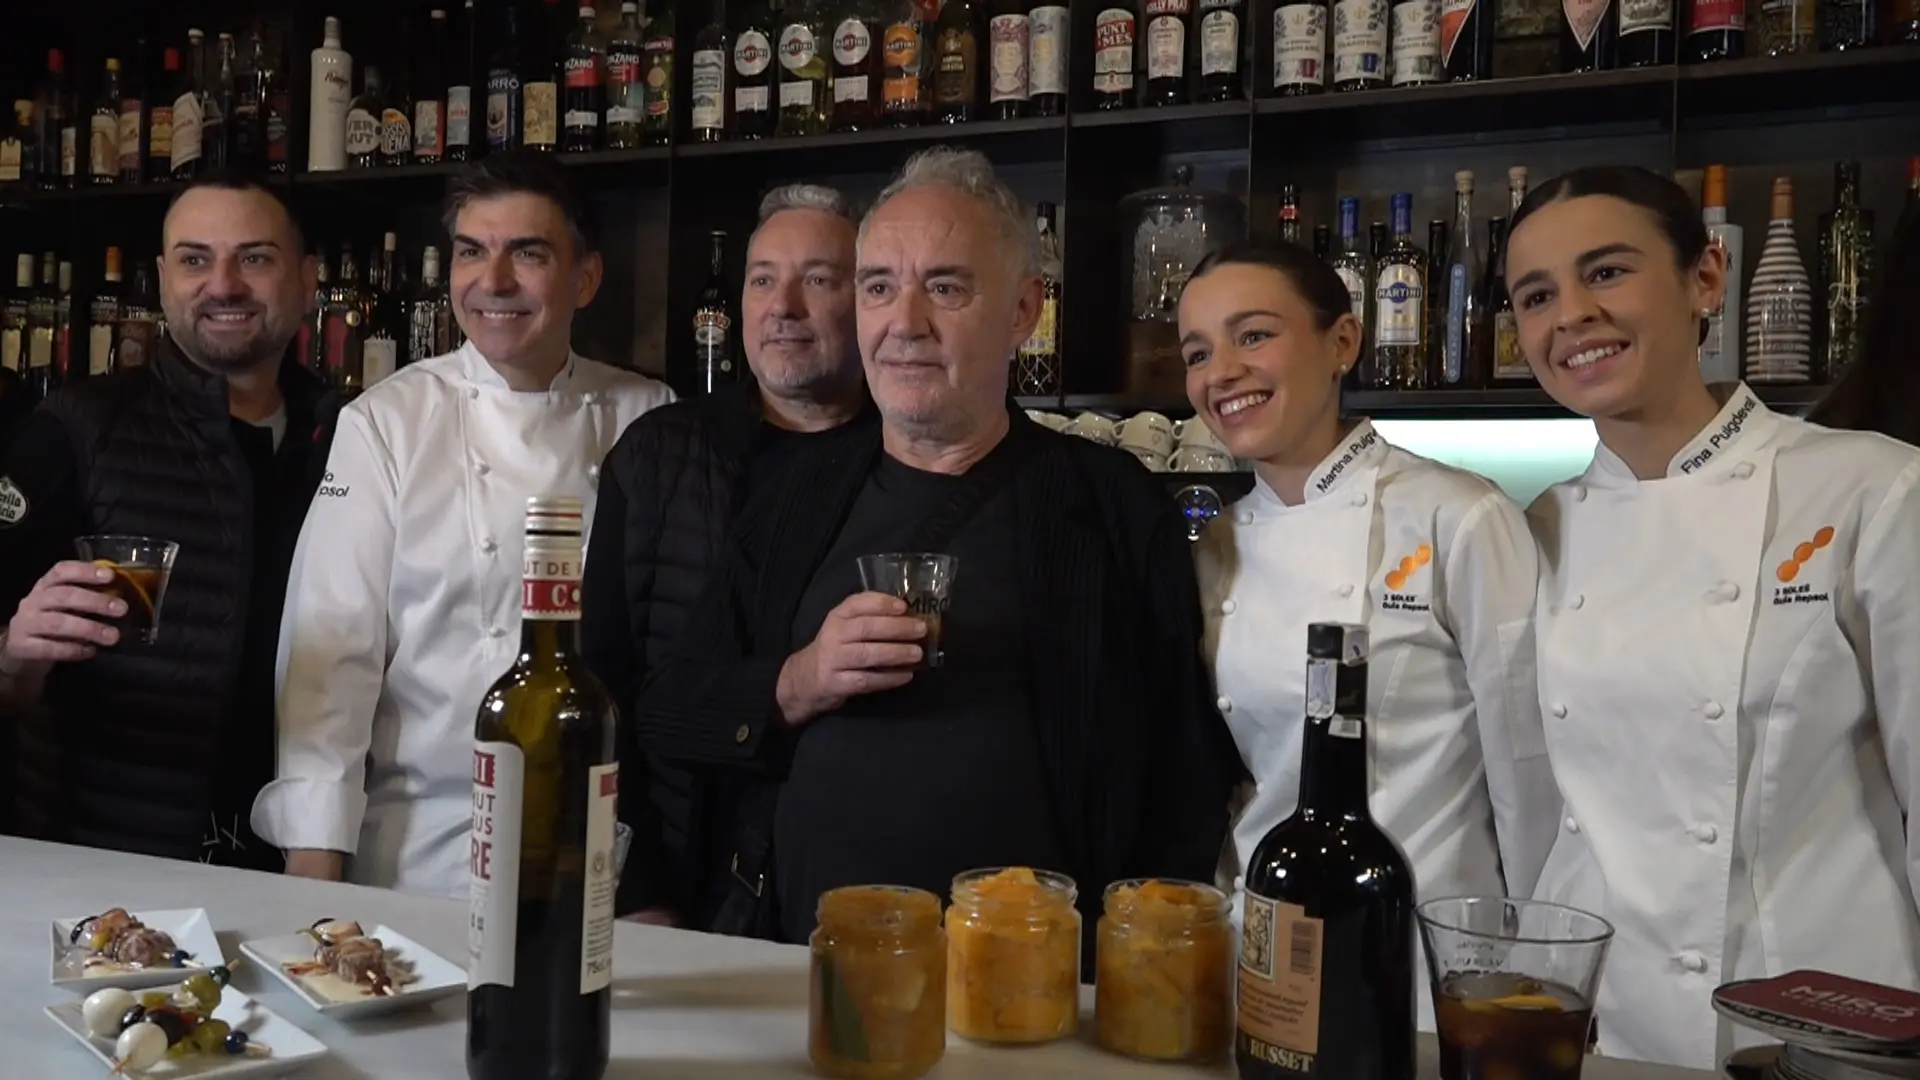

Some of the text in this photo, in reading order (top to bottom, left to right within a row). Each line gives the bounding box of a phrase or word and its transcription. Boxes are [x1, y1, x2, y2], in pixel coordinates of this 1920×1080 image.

[1097, 21, 1127, 38] PUNT
[781, 42, 813, 54] MARTINI
[835, 37, 868, 49] MARTINI
[886, 41, 915, 51] MARTINI
[736, 48, 768, 60] MARTINI
[1376, 286, 1421, 299] MARTINI
[1680, 448, 1712, 475] Fina
[1315, 453, 1353, 493] Martina
[546, 561, 570, 577] DE
[1782, 583, 1810, 595] SOLES
[1391, 593, 1416, 603] SOLES
[1794, 592, 1830, 603] Repsol
[1249, 1038, 1315, 1074] RUSSET
